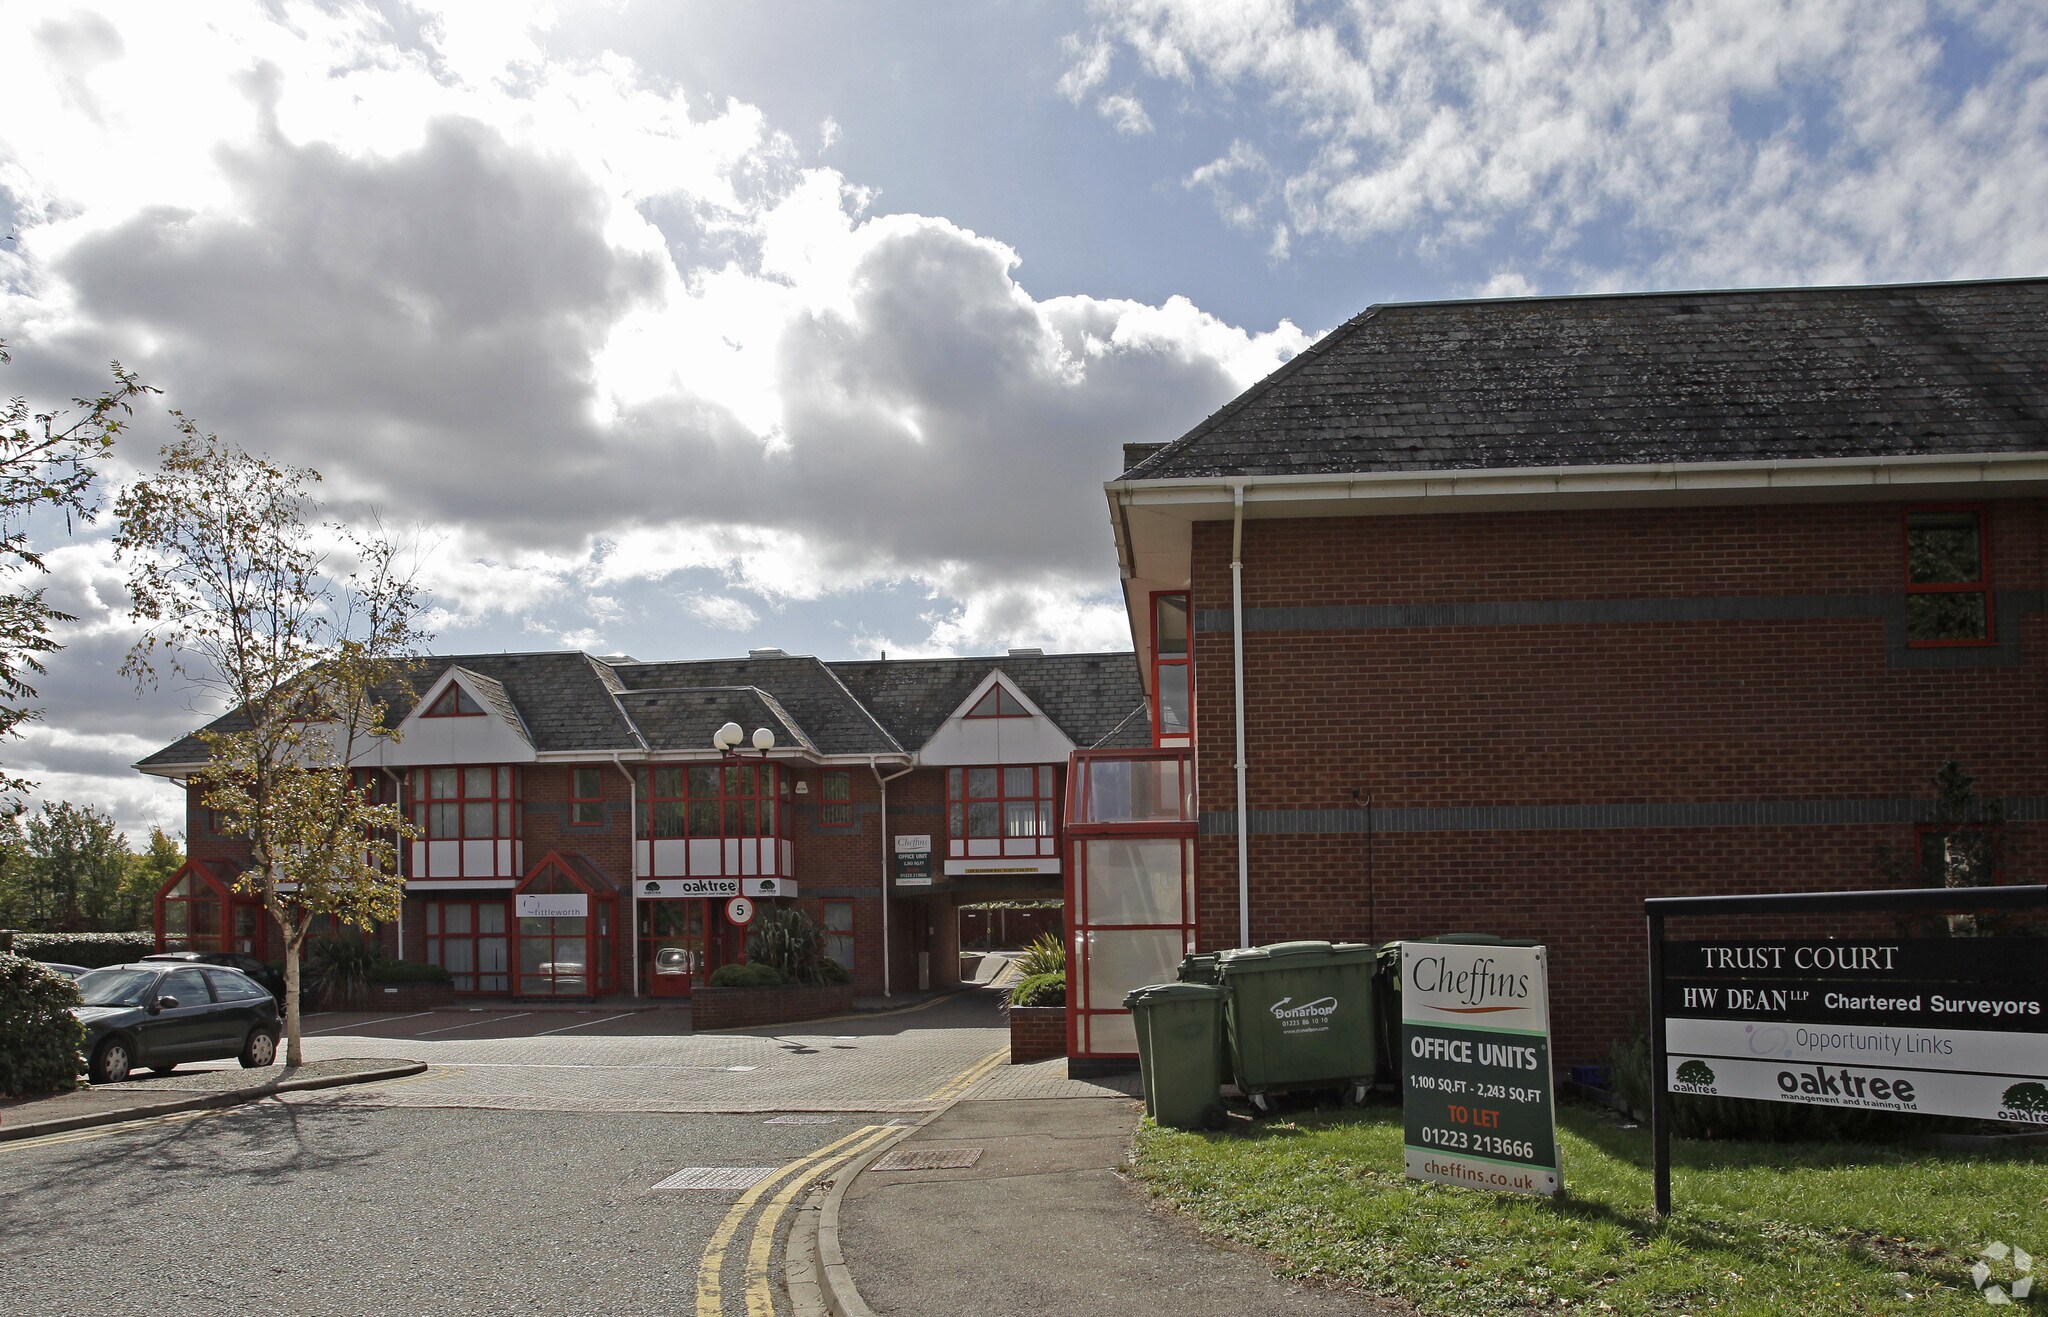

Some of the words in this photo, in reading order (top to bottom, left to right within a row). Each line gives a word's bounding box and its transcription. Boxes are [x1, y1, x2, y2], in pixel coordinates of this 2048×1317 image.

[682, 879, 737, 892] oaktree
[534, 908, 581, 916] fittleworth
[736, 904, 745, 916] 5
[1701, 946, 1786, 969] TRUST
[1794, 946, 1899, 970] COURT
[1412, 956, 1529, 1005] Cheffins
[1275, 1005, 1333, 1019] Donarbon
[1683, 987, 1719, 1008] HW
[1726, 988, 1788, 1012] DEAN
[1790, 990, 1809, 1001] LLP
[1824, 992, 1921, 1011] Chartered
[1930, 995, 2041, 1017] Surveyors
[1281, 1019, 1300, 1027] 01223
[1410, 1036, 1473, 1064] OFFICE
[1478, 1042, 1538, 1071] UNITS
[1795, 1028, 1902, 1056] Opportunity
[1906, 1034, 1953, 1055] Links
[1410, 1074, 1435, 1089] 1,100
[1437, 1078, 1467, 1094] SQ.FT
[1477, 1083, 1506, 1098] 2,243
[1508, 1087, 1542, 1103] SQ.FT
[1776, 1066, 1916, 1102] oaktree
[1780, 1092, 1840, 1104] management
[1842, 1098, 1861, 1106] and
[1863, 1099, 1901, 1111] training
[1903, 1102, 1918, 1111] ltd
[1447, 1104, 1469, 1124] TO
[1472, 1108, 1500, 1129] LET
[1422, 1126, 1468, 1149] 01223
[1473, 1134, 1534, 1159] 213666
[1424, 1160, 1533, 1189] cheffins.co.uk
